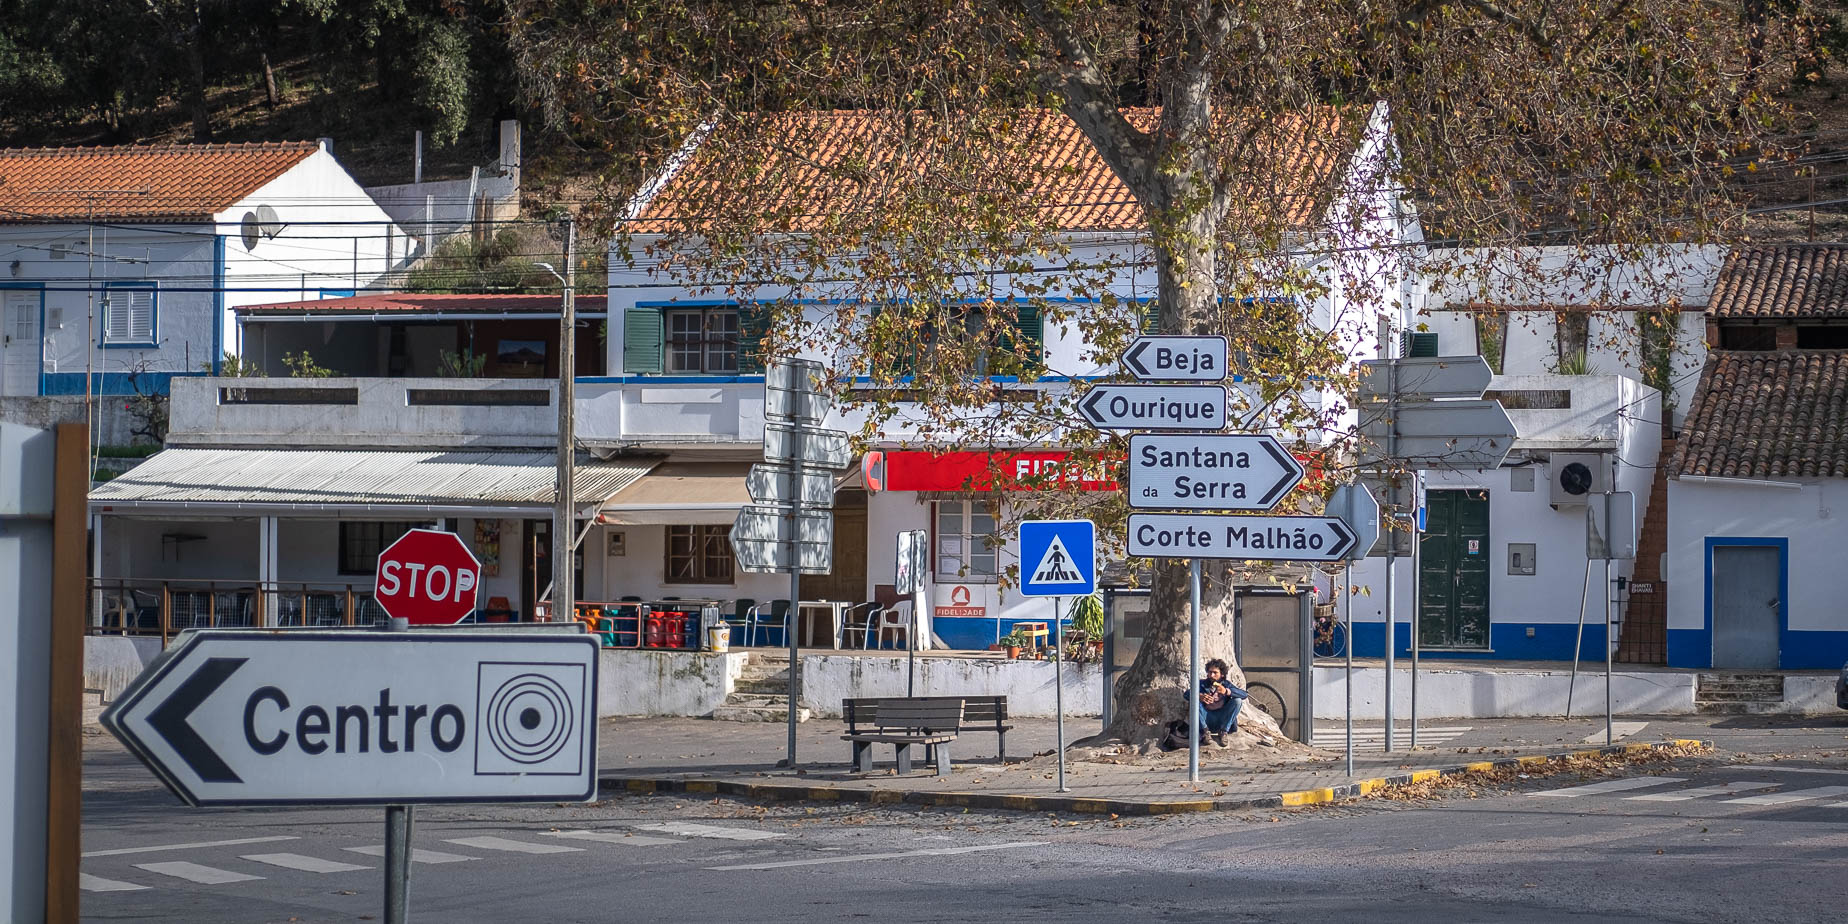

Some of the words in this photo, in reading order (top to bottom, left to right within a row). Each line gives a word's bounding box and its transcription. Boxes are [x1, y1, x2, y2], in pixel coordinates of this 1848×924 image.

[1156, 348, 1214, 374] Beja
[1110, 395, 1215, 422] Ourique
[1140, 445, 1250, 468] Santana
[1142, 486, 1158, 498] da
[1173, 476, 1246, 499] Serra
[1136, 524, 1212, 548] Corte
[1226, 526, 1324, 550] Malhão
[379, 560, 475, 603] STOP
[936, 608, 983, 616] FIDELIDADE
[243, 686, 466, 755] Centro
